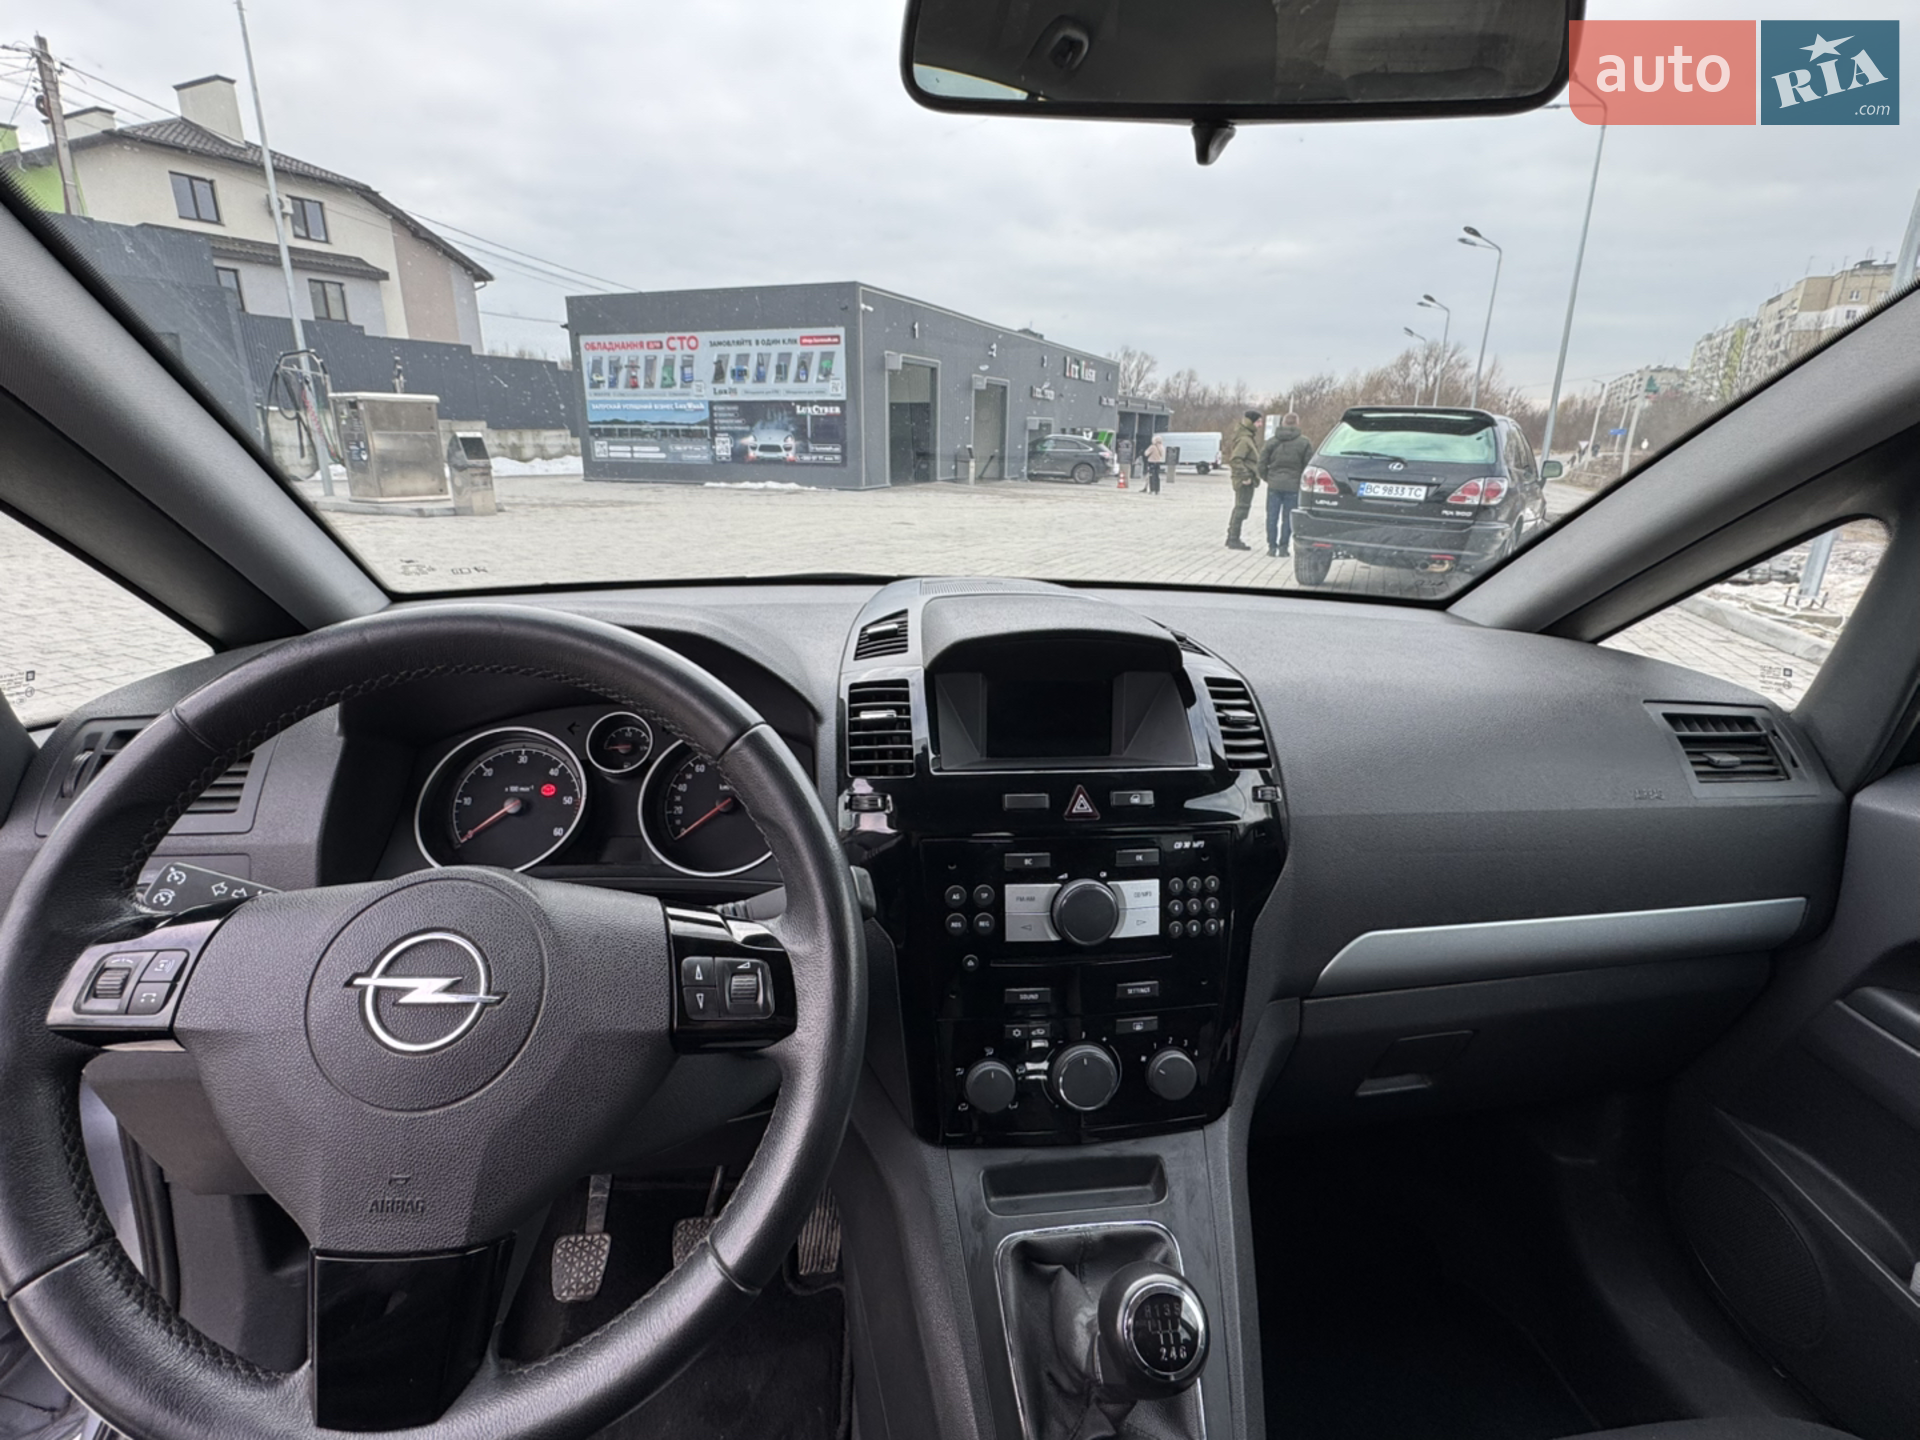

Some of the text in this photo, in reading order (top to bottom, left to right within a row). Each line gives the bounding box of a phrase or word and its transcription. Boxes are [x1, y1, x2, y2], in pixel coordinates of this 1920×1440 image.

[584, 340, 645, 352] ОБЛАДНАННЯ
[666, 335, 700, 352] СТО
[1382, 485, 1406, 496] 9833
[517, 755, 528, 764] 30
[483, 767, 493, 776] 20
[549, 767, 559, 776] 40
[694, 764, 705, 773] 60
[678, 783, 688, 792] 40
[463, 797, 472, 806] 10
[563, 796, 573, 805] 50
[673, 806, 683, 815] 20
[553, 827, 563, 837] 60
[1168, 1036, 1173, 1045] 2
[368, 1198, 425, 1213] AIRBAG
[1170, 1346, 1178, 1360] 4
[1180, 1345, 1187, 1359] 6
